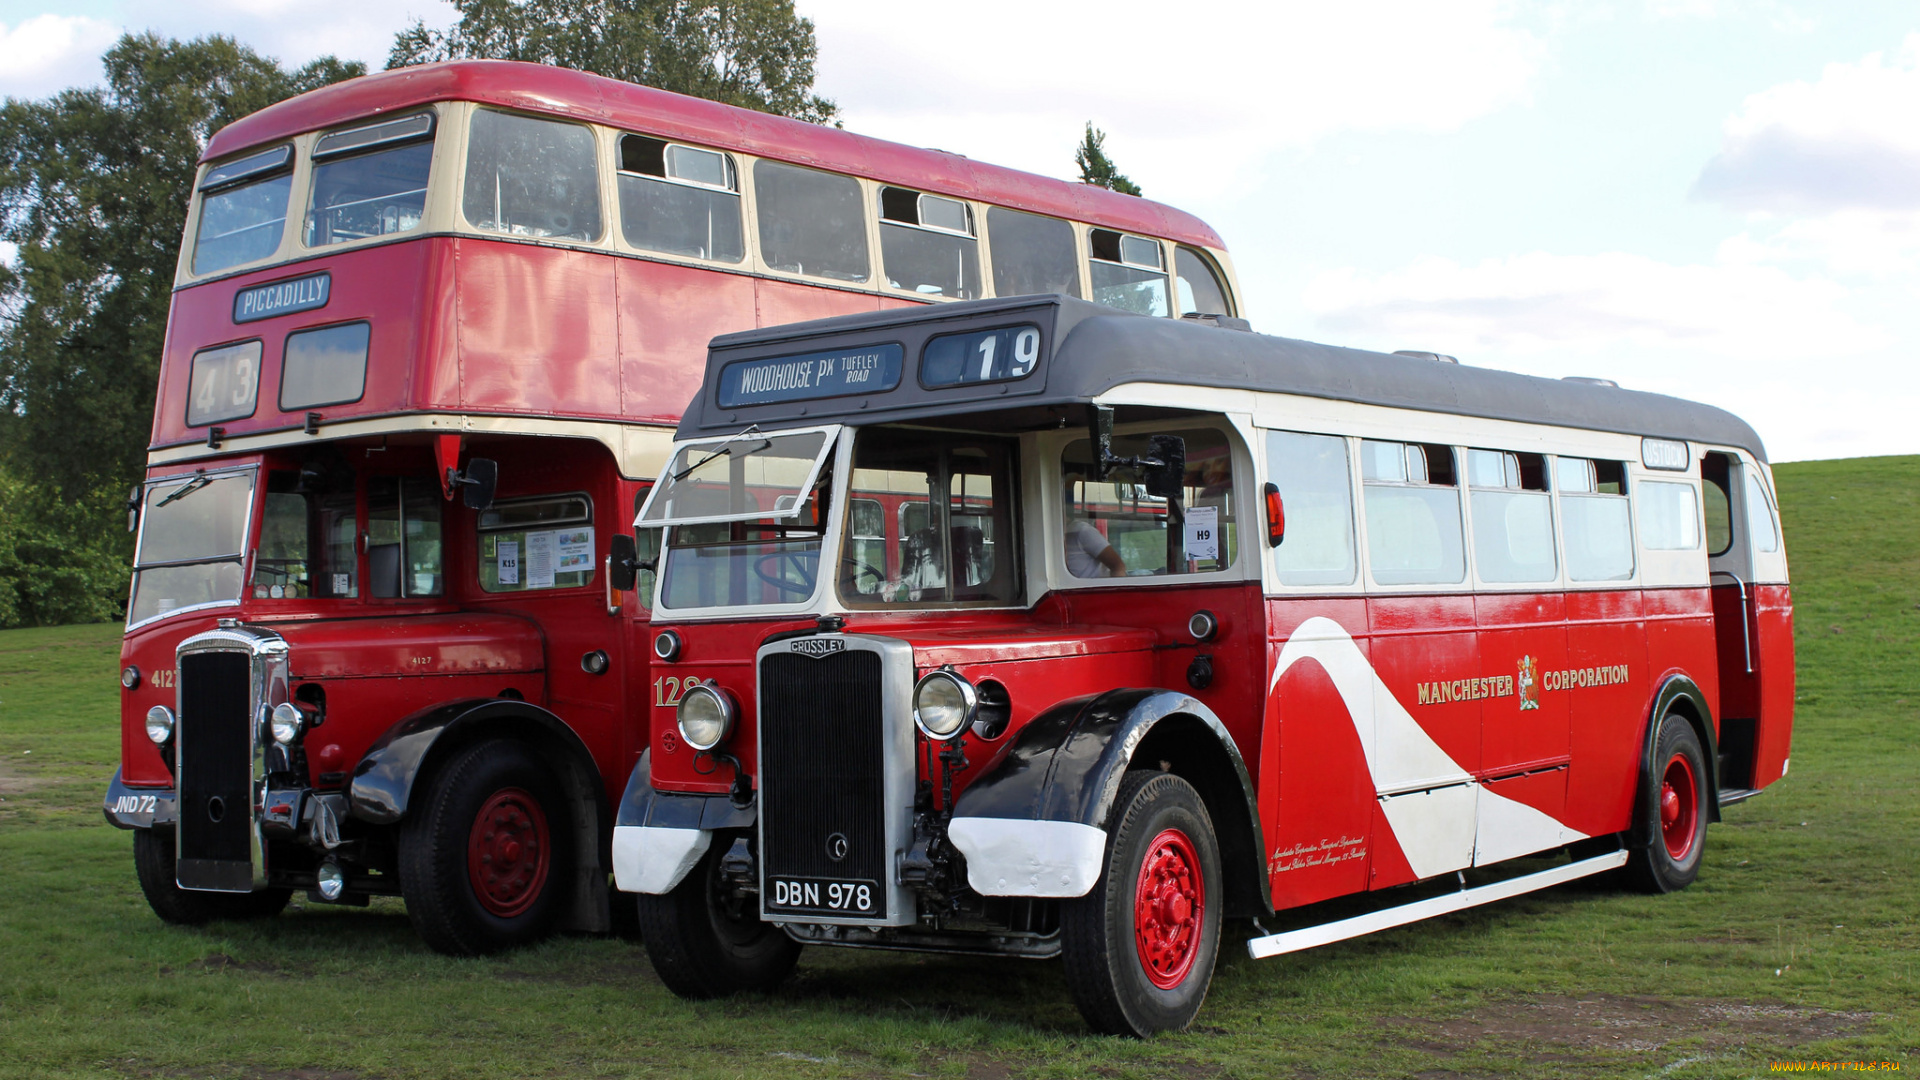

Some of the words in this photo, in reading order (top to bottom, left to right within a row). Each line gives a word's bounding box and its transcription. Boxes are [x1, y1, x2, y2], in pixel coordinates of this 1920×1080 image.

[243, 276, 326, 315] PICCADILLY
[841, 354, 879, 371] TUFFLEY
[741, 360, 814, 394] WOODHOUSE
[845, 369, 870, 384] ROAD
[1196, 530, 1211, 541] H9
[502, 558, 516, 568] K15
[791, 639, 843, 654] CROSSLEY
[411, 656, 432, 665] 4127
[1417, 675, 1514, 705] MANCHESTER
[1543, 664, 1630, 691] CORPORATION
[111, 795, 139, 814] JND
[775, 881, 820, 906] DBN
[827, 883, 872, 911] 978
